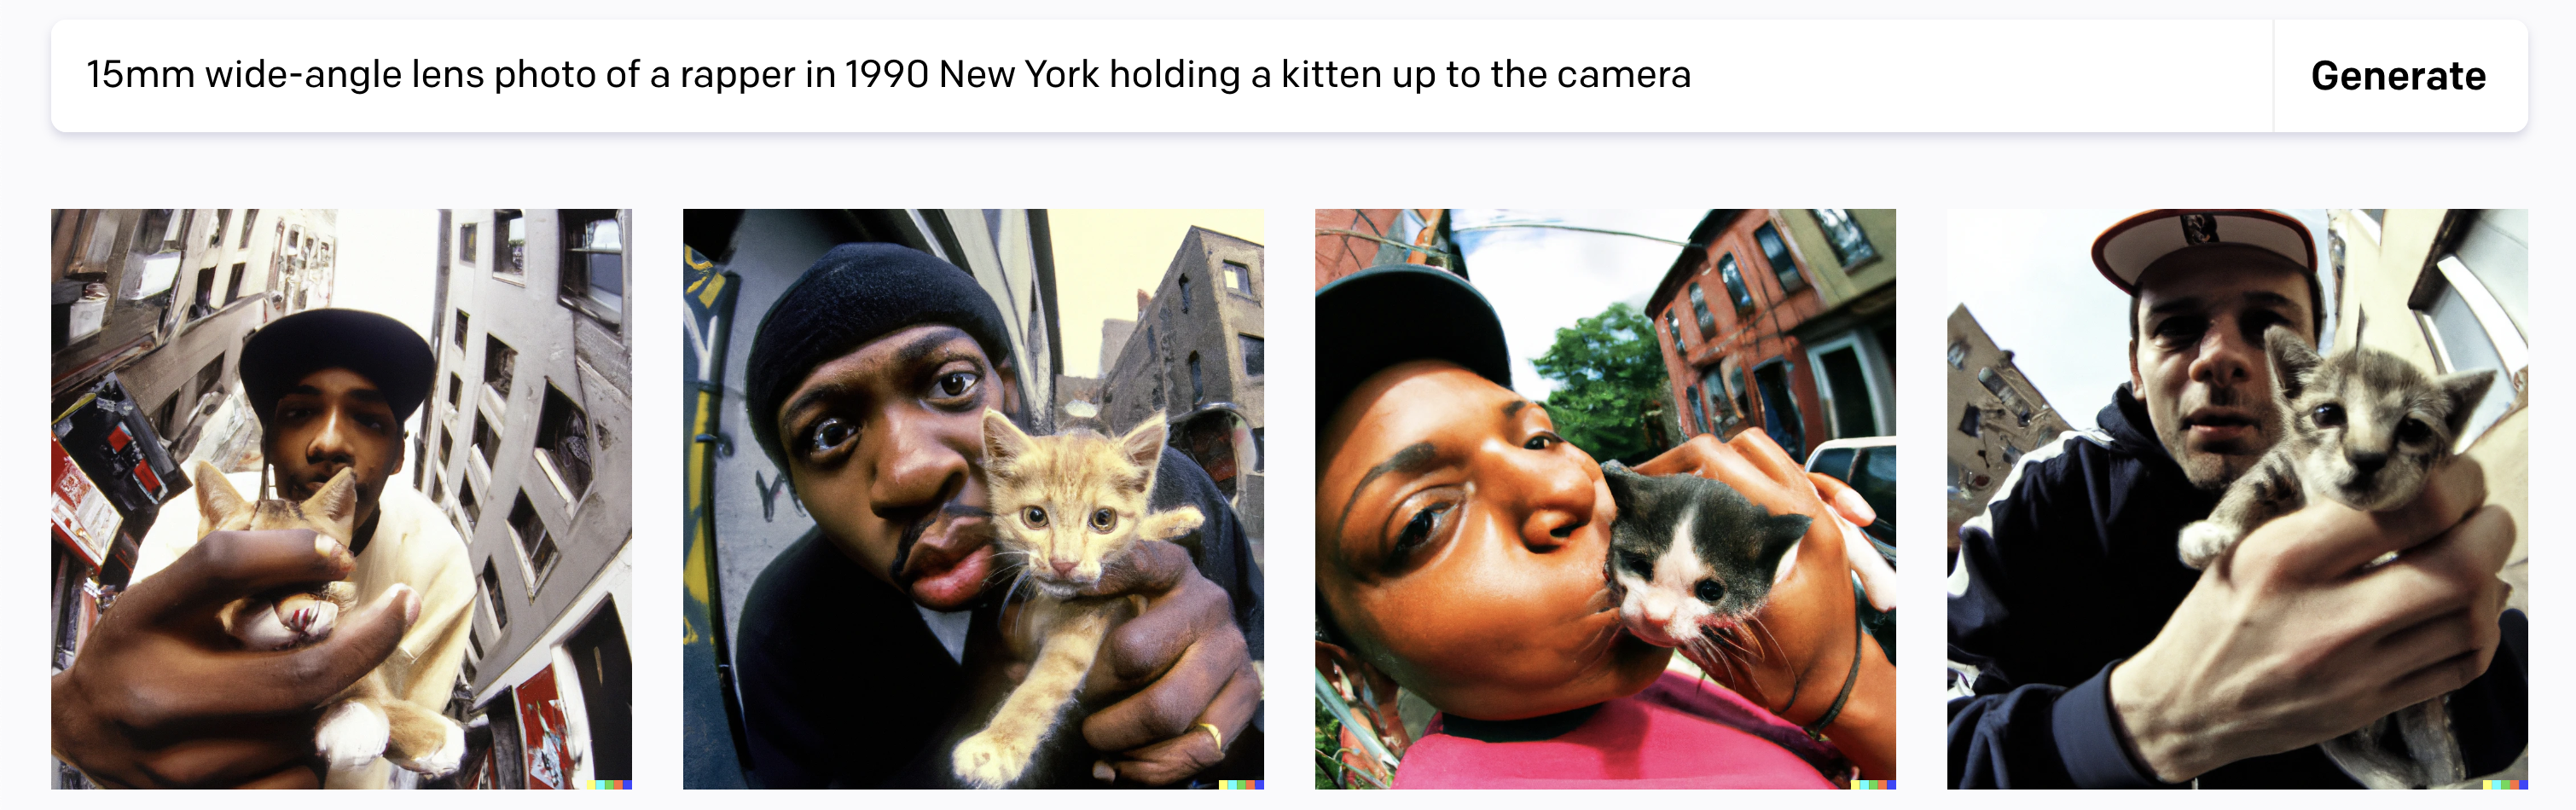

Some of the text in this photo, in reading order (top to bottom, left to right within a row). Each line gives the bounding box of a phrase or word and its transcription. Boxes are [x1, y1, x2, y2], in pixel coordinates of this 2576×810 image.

[88, 59, 1690, 94] 15mm wide-angle lens photo of a rapper in 1990 New York holding a kitten up to the camera
[2312, 61, 2486, 90] Generate
